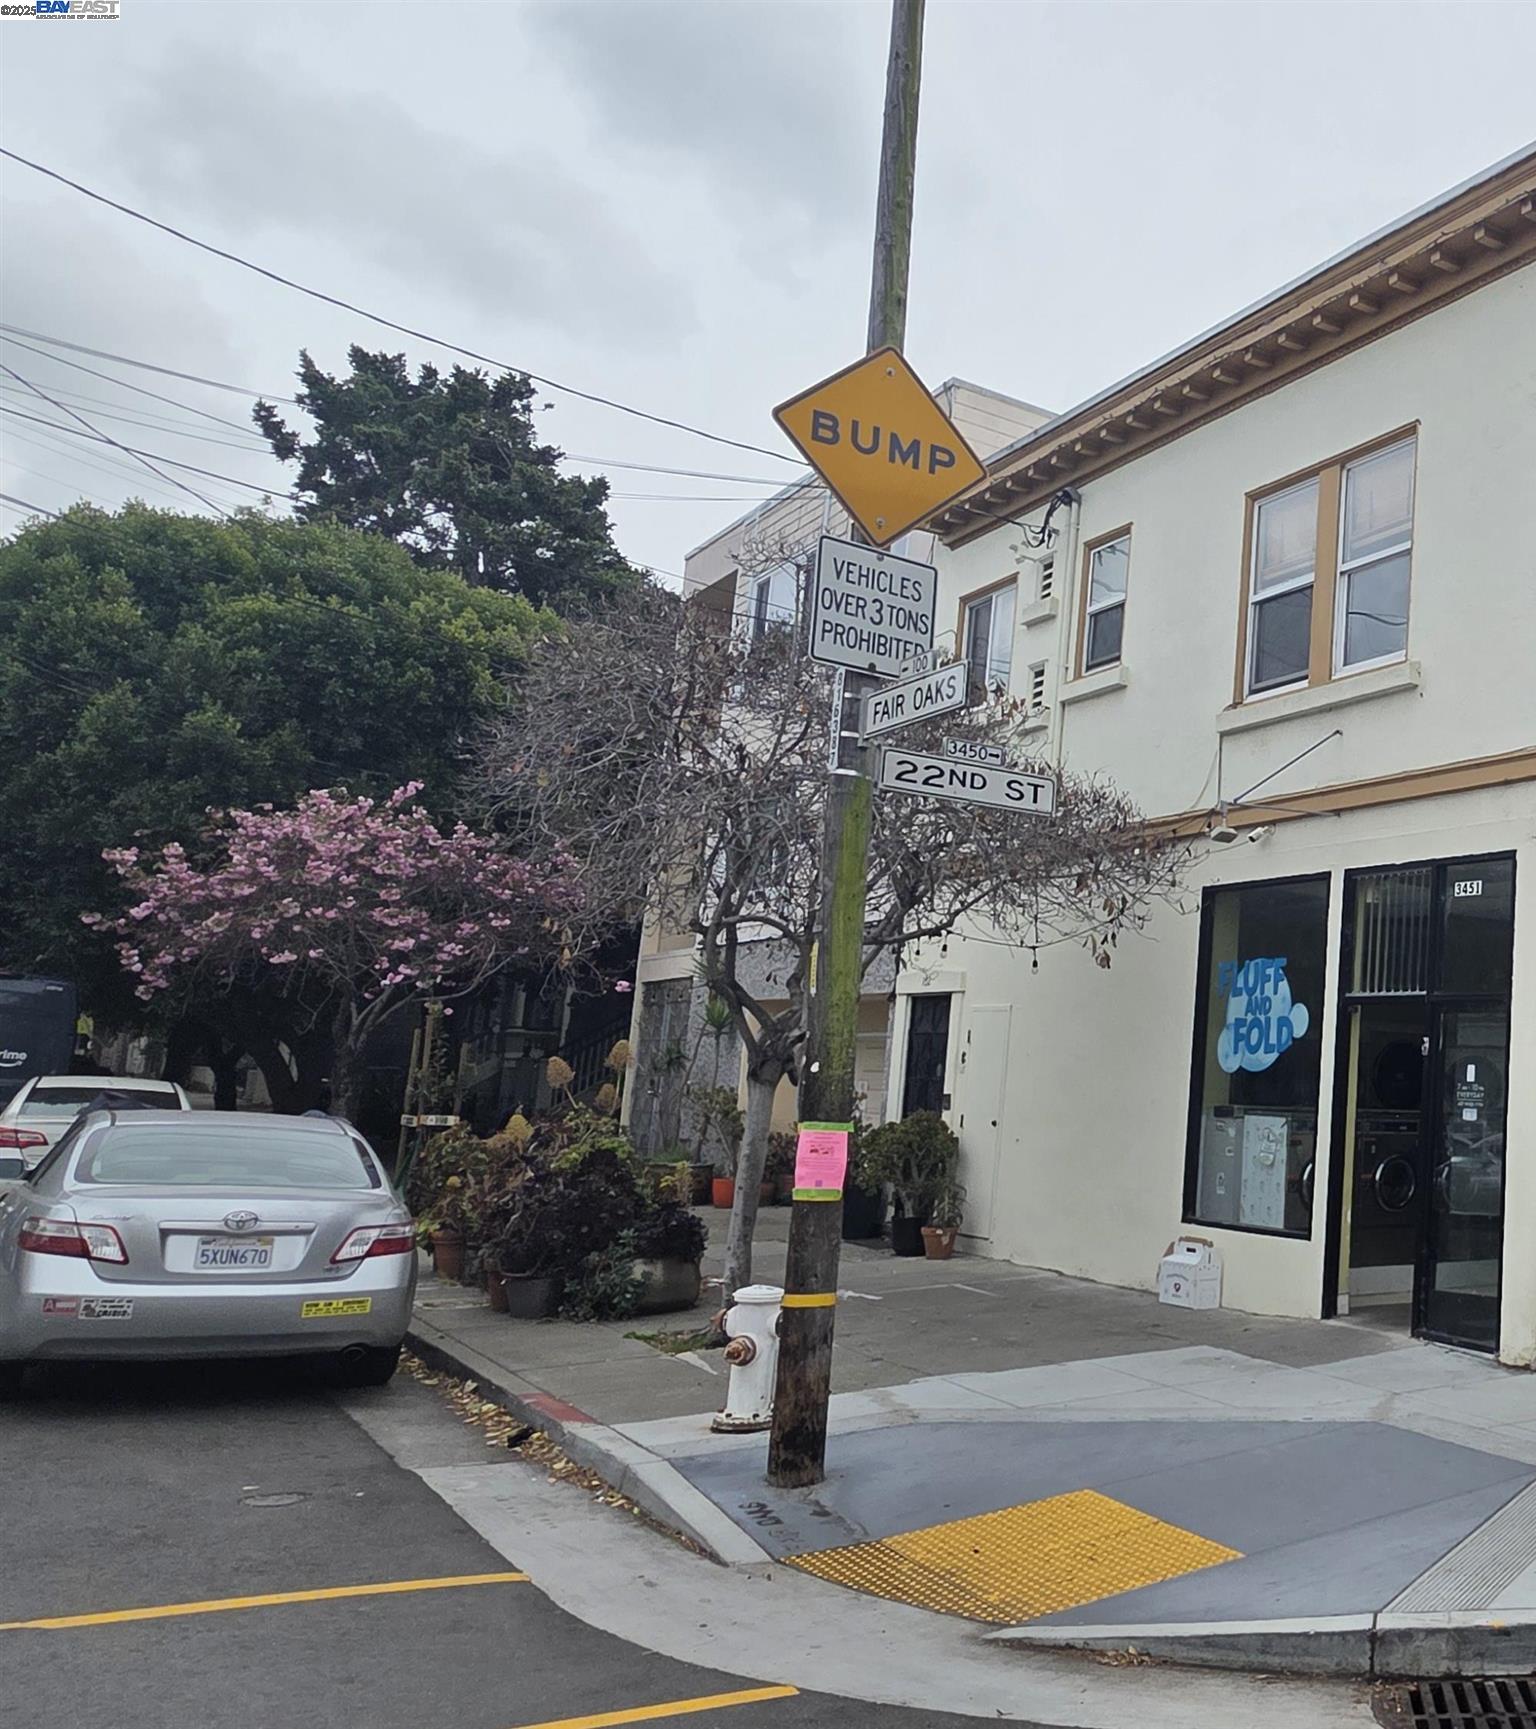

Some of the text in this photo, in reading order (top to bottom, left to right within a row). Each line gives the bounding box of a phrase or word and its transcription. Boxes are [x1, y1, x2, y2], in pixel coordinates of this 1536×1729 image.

[812, 410, 955, 475] BUMP
[833, 557, 922, 602] VEHICLES
[821, 587, 930, 636] OVER 3 TONS
[821, 620, 926, 660] PROHIBITED
[872, 675, 957, 725] FAIR OAKS
[949, 742, 988, 761] 3450
[894, 760, 1046, 804] 22ND ST
[1456, 882, 1480, 895] 3451
[1217, 957, 1288, 998] FLUFF
[1245, 995, 1273, 1017] AND
[0, 1049, 27, 1060] rime
[1233, 1015, 1294, 1055] FOLD
[200, 1248, 268, 1265] 5XUN670
